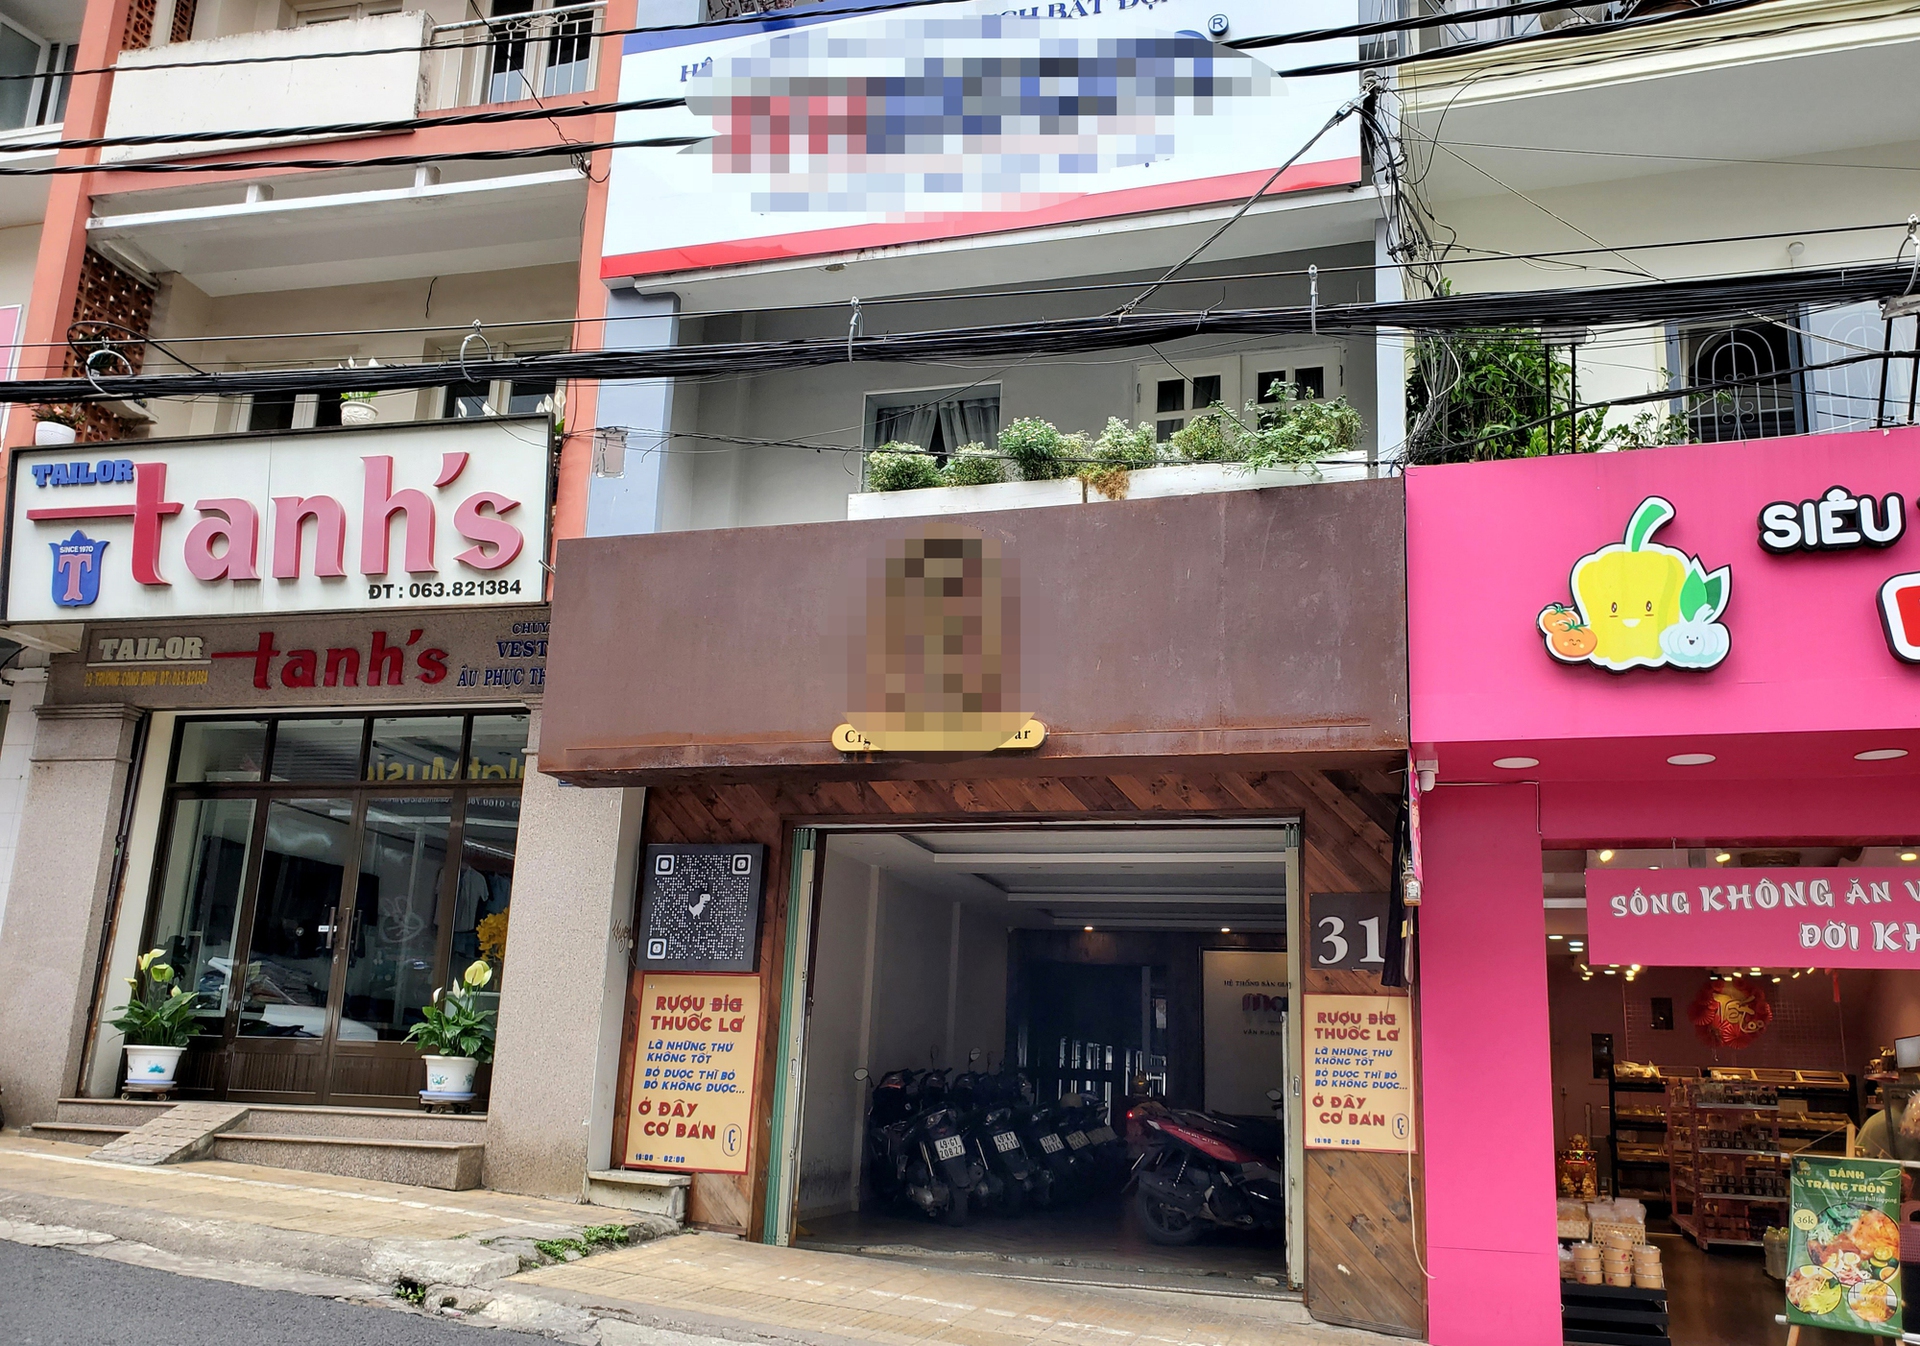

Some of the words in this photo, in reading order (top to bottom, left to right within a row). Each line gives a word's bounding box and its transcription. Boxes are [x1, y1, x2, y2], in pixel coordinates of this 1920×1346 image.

[32, 459, 134, 487] TAILOR
[27, 451, 523, 587] tanh's
[1763, 487, 1902, 549] SIÊU
[409, 580, 521, 598] 063.821384
[99, 637, 204, 660] TAILOR
[211, 629, 449, 690] tanh's
[1610, 888, 1690, 917] SỐNG
[1699, 878, 1834, 911] KHÔNG
[1846, 879, 1891, 905] ĂN
[1318, 916, 1385, 964] 31
[1800, 920, 1858, 949] ĐỜI
[655, 994, 705, 1013] RƯỢU
[651, 1012, 712, 1031] THUỐC
[1317, 1011, 1362, 1026] RƯỢU
[1315, 1024, 1371, 1041] THUỐC
[658, 1098, 699, 1118] ĐÂY
[1330, 1094, 1367, 1110] ĐÂY
[1828, 1167, 1865, 1179] BÁNH
[1806, 1180, 1848, 1191] TRÁNG
[1850, 1181, 1886, 1196] TRỘN
